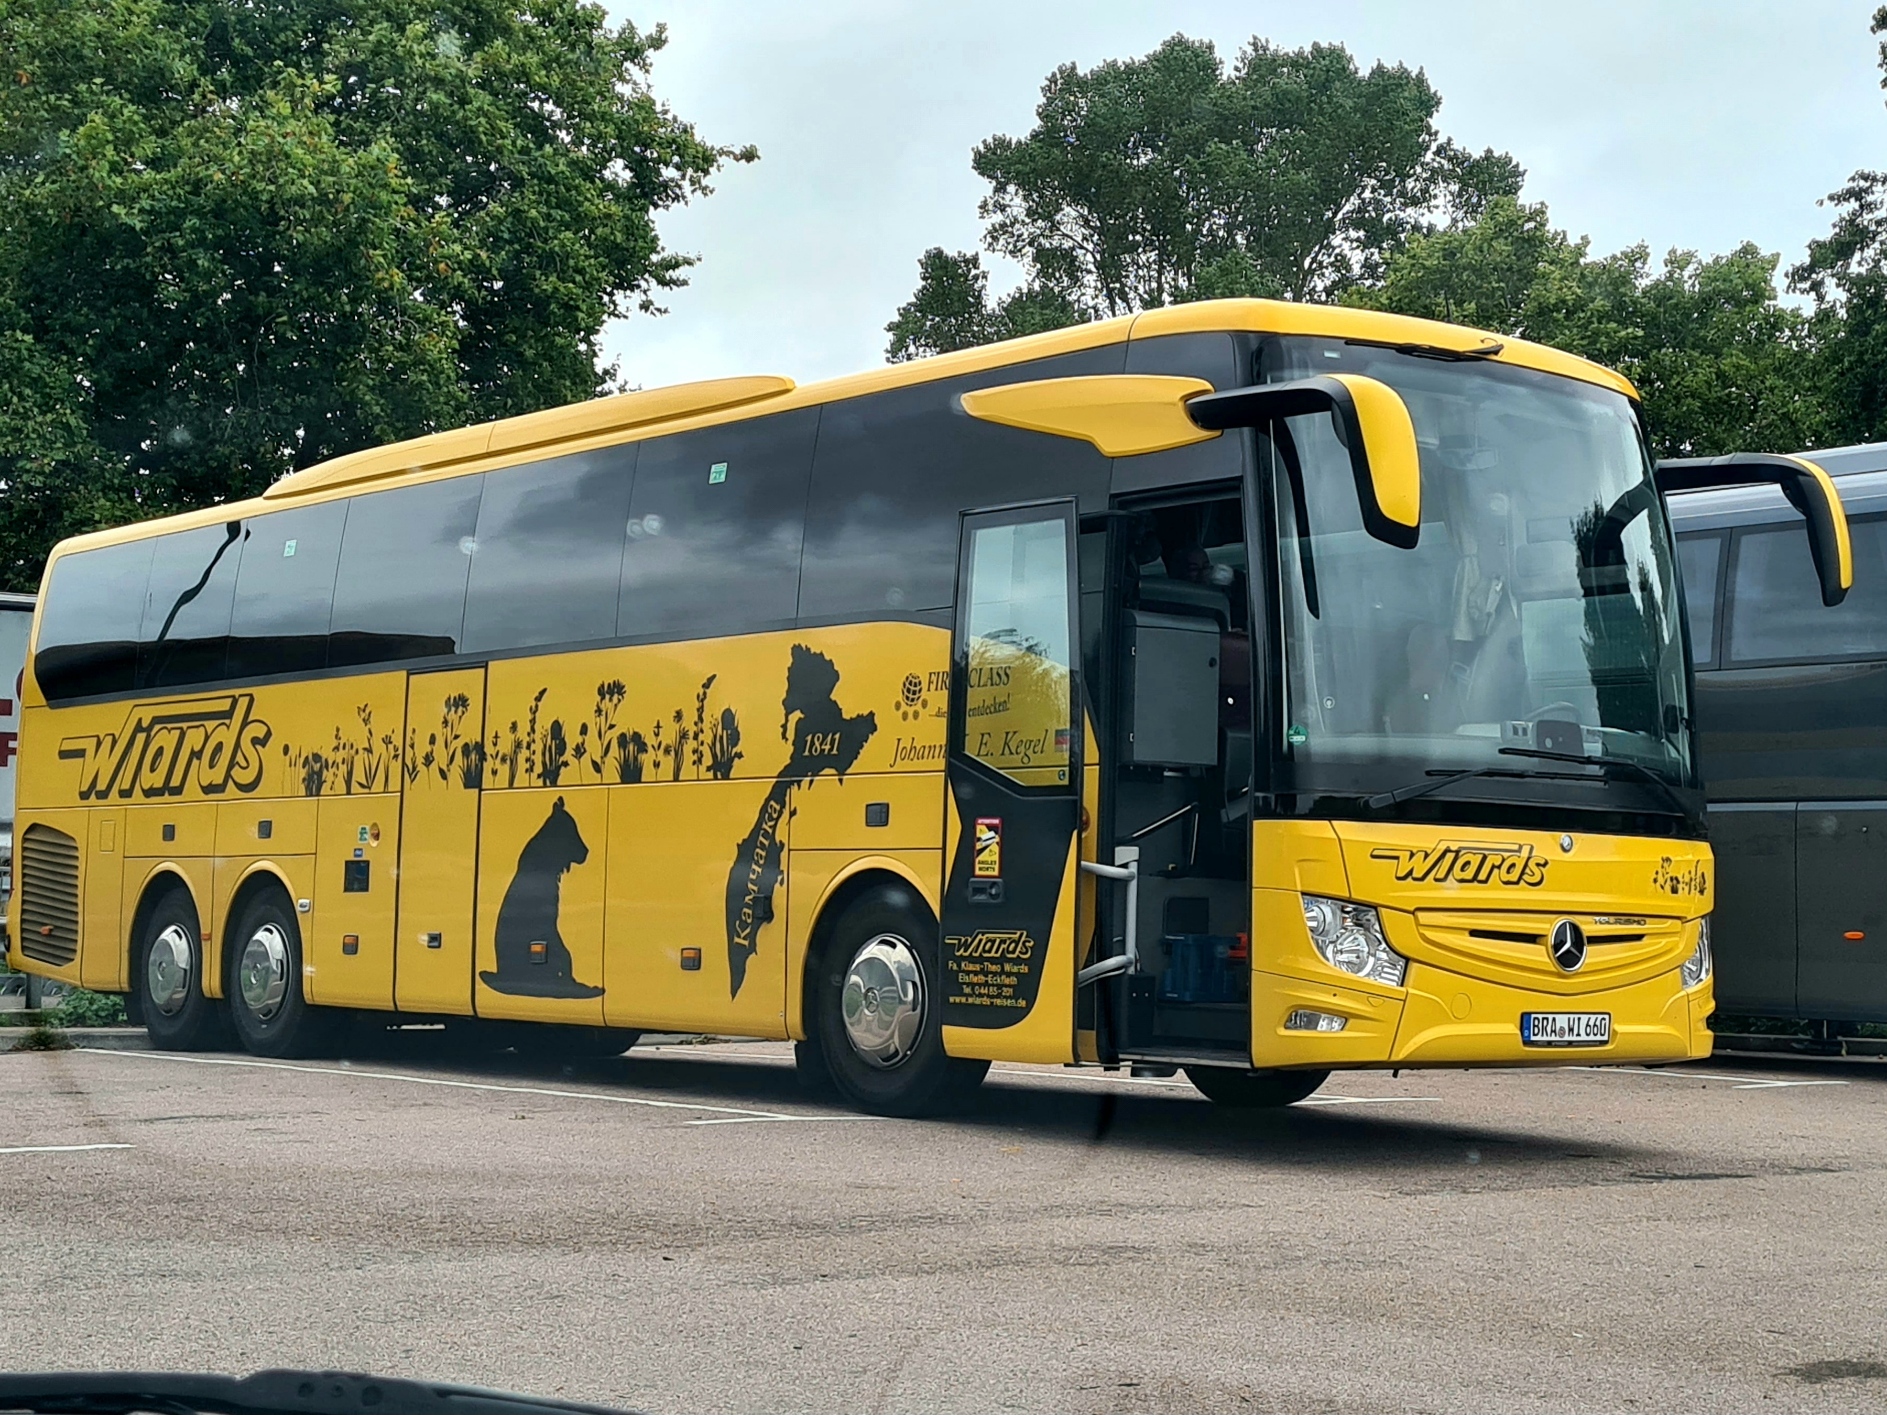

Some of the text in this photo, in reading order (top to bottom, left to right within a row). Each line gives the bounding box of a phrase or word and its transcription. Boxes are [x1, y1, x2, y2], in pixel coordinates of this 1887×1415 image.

[927, 666, 1011, 692] FIR CLASS
[802, 732, 841, 756] 1841
[889, 729, 1049, 768] Johann E. Kegel
[733, 798, 781, 948] Камчатка
[1003, 962, 1029, 973] Wiards
[1532, 1016, 1607, 1037] BRA WI 660
